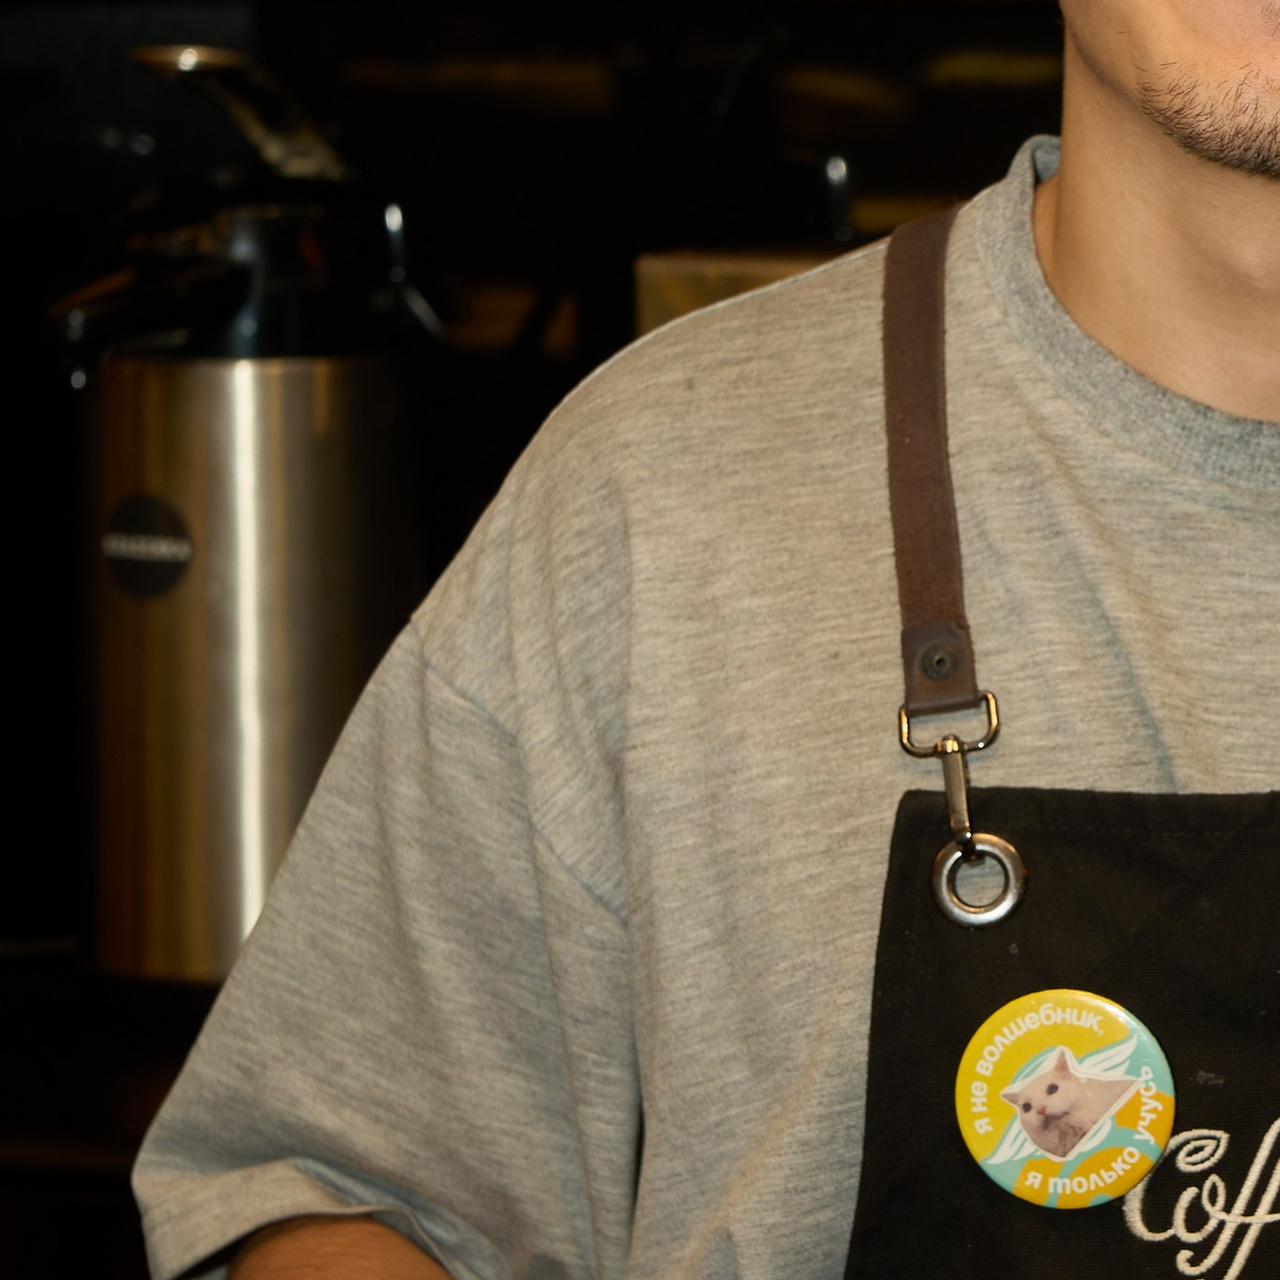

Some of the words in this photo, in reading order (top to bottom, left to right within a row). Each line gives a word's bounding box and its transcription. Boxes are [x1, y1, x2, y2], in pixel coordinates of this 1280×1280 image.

[970, 1080, 989, 1115] не
[1048, 1146, 1141, 1195] только
[1133, 1065, 1163, 1145] учусь
